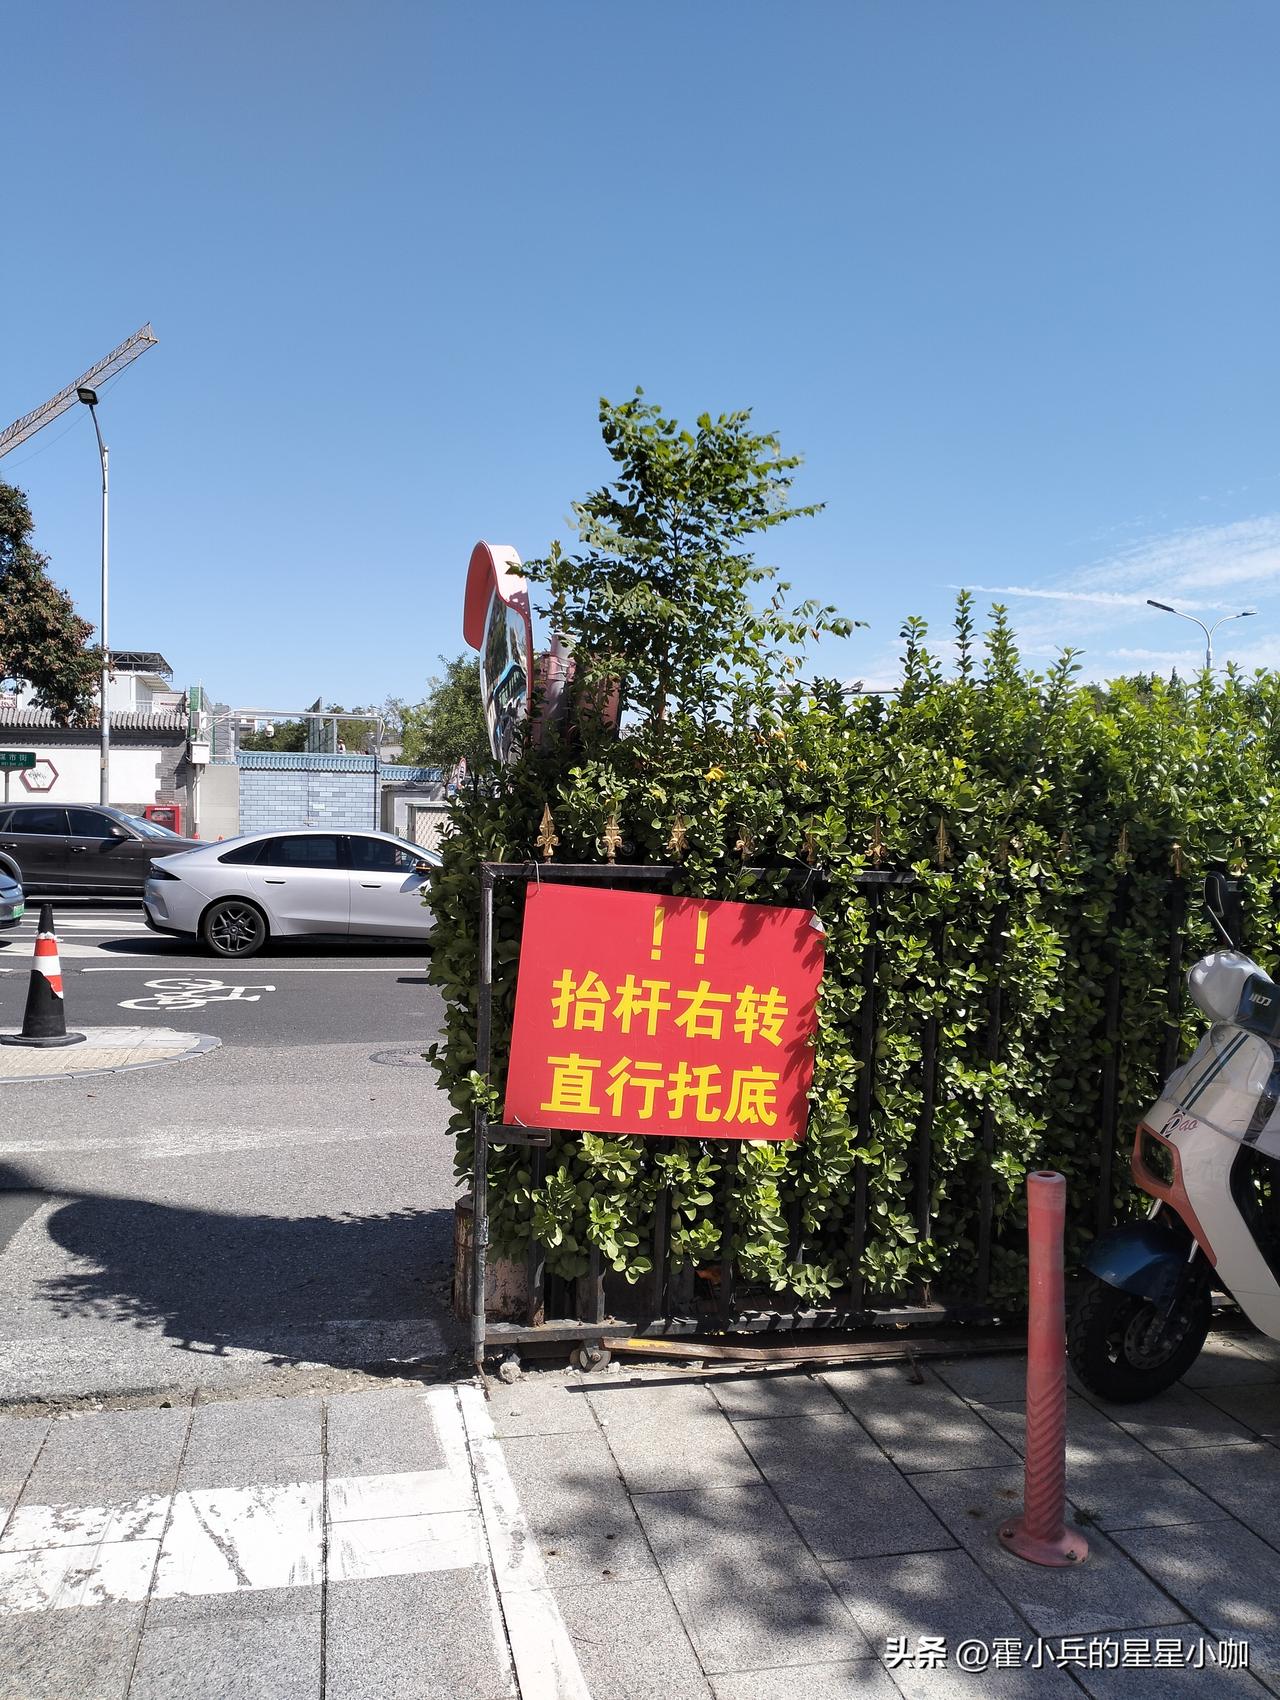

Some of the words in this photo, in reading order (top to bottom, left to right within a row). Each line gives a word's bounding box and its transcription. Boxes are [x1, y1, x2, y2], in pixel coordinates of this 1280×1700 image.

[551, 968, 789, 1047] 抬杆右转
[540, 1053, 780, 1126] 直行托底
